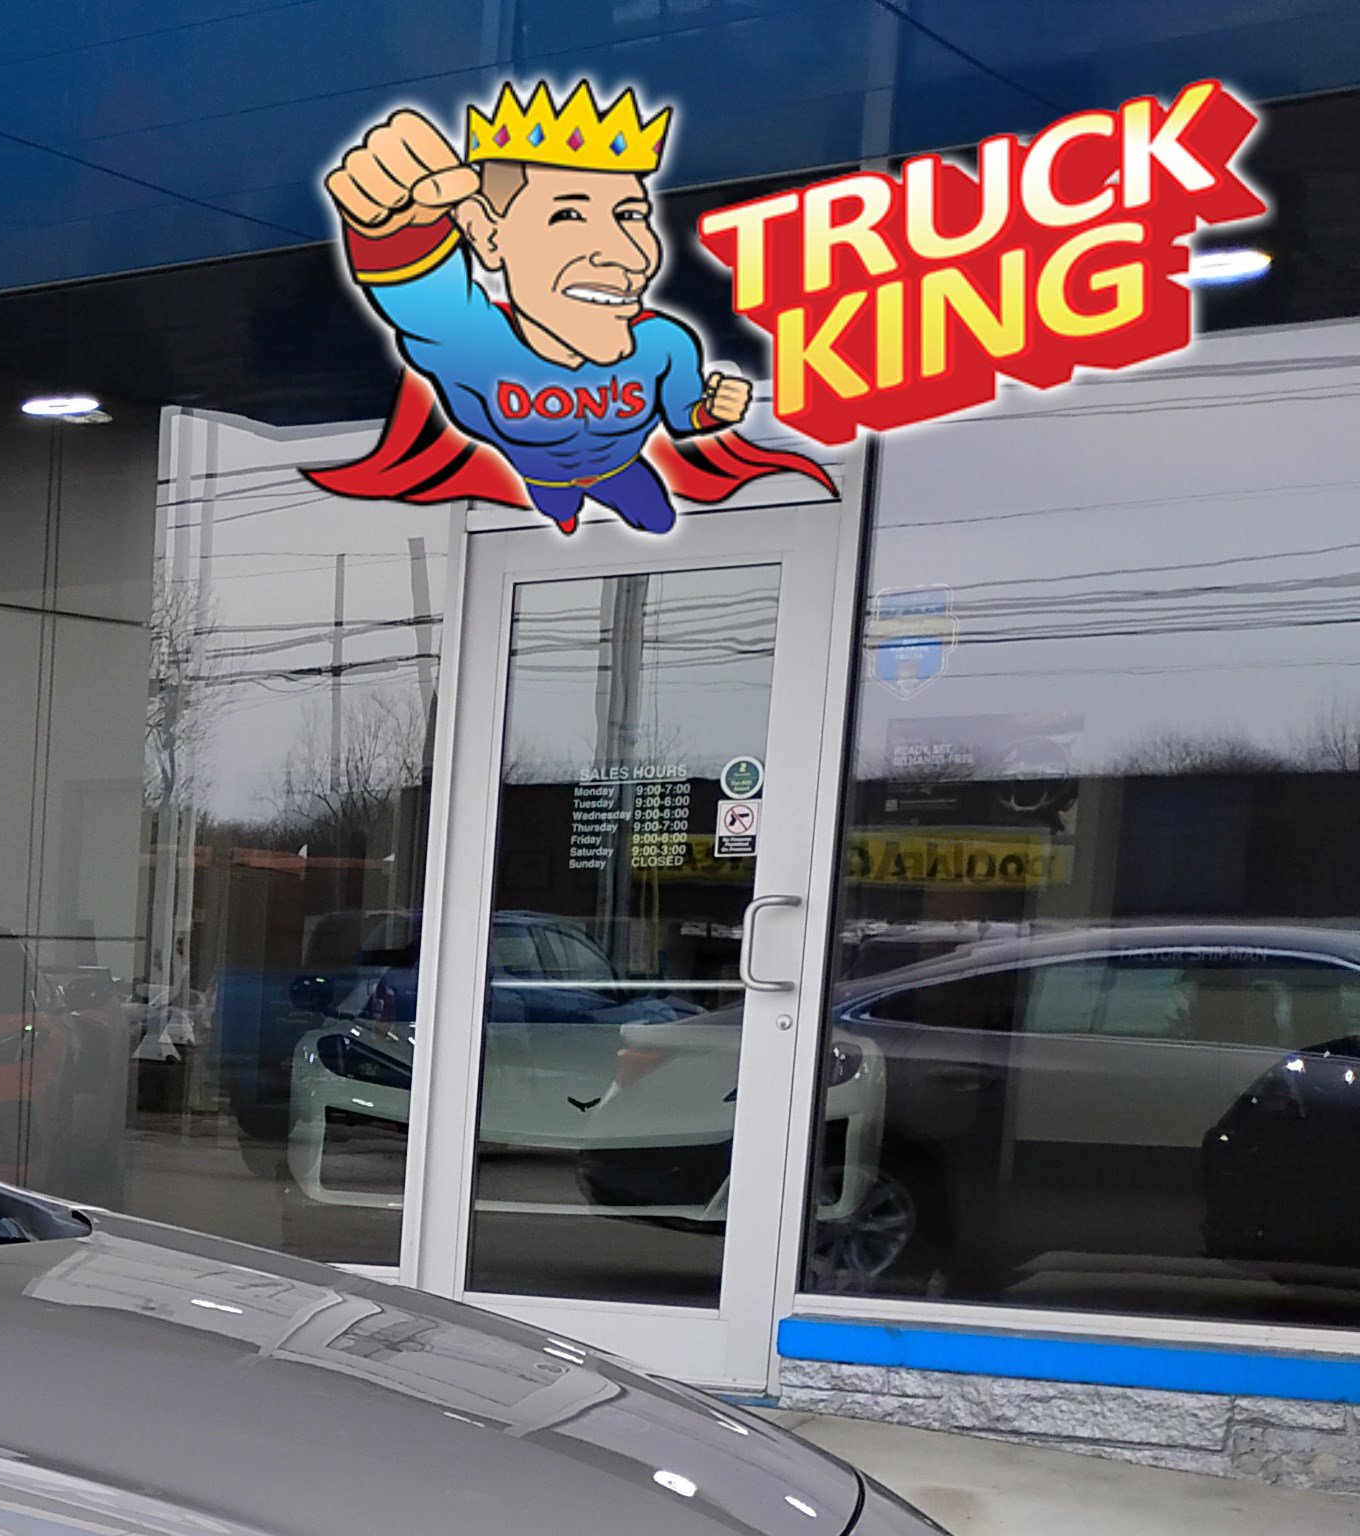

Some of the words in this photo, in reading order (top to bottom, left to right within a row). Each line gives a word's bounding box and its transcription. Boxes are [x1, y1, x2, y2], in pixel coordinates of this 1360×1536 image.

[579, 767, 629, 781] SALES
[632, 764, 688, 779] HOURS
[574, 787, 616, 797] Monday
[636, 784, 691, 796] 9:00-7:00
[573, 799, 615, 810] Tuesday
[635, 796, 690, 808] 9:00-6:00
[572, 810, 632, 821] Wednesday
[634, 808, 689, 820] 9:00-6:00
[572, 823, 619, 833] Thursday
[633, 821, 688, 832] 9:00-7:00
[570, 835, 602, 846] Friday
[632, 833, 688, 844] 9:00-6:00
[569, 847, 614, 858] Saturday
[631, 845, 686, 856] 9:00-3:00
[568, 859, 607, 870] Sunday
[631, 856, 684, 868] CLOSED
